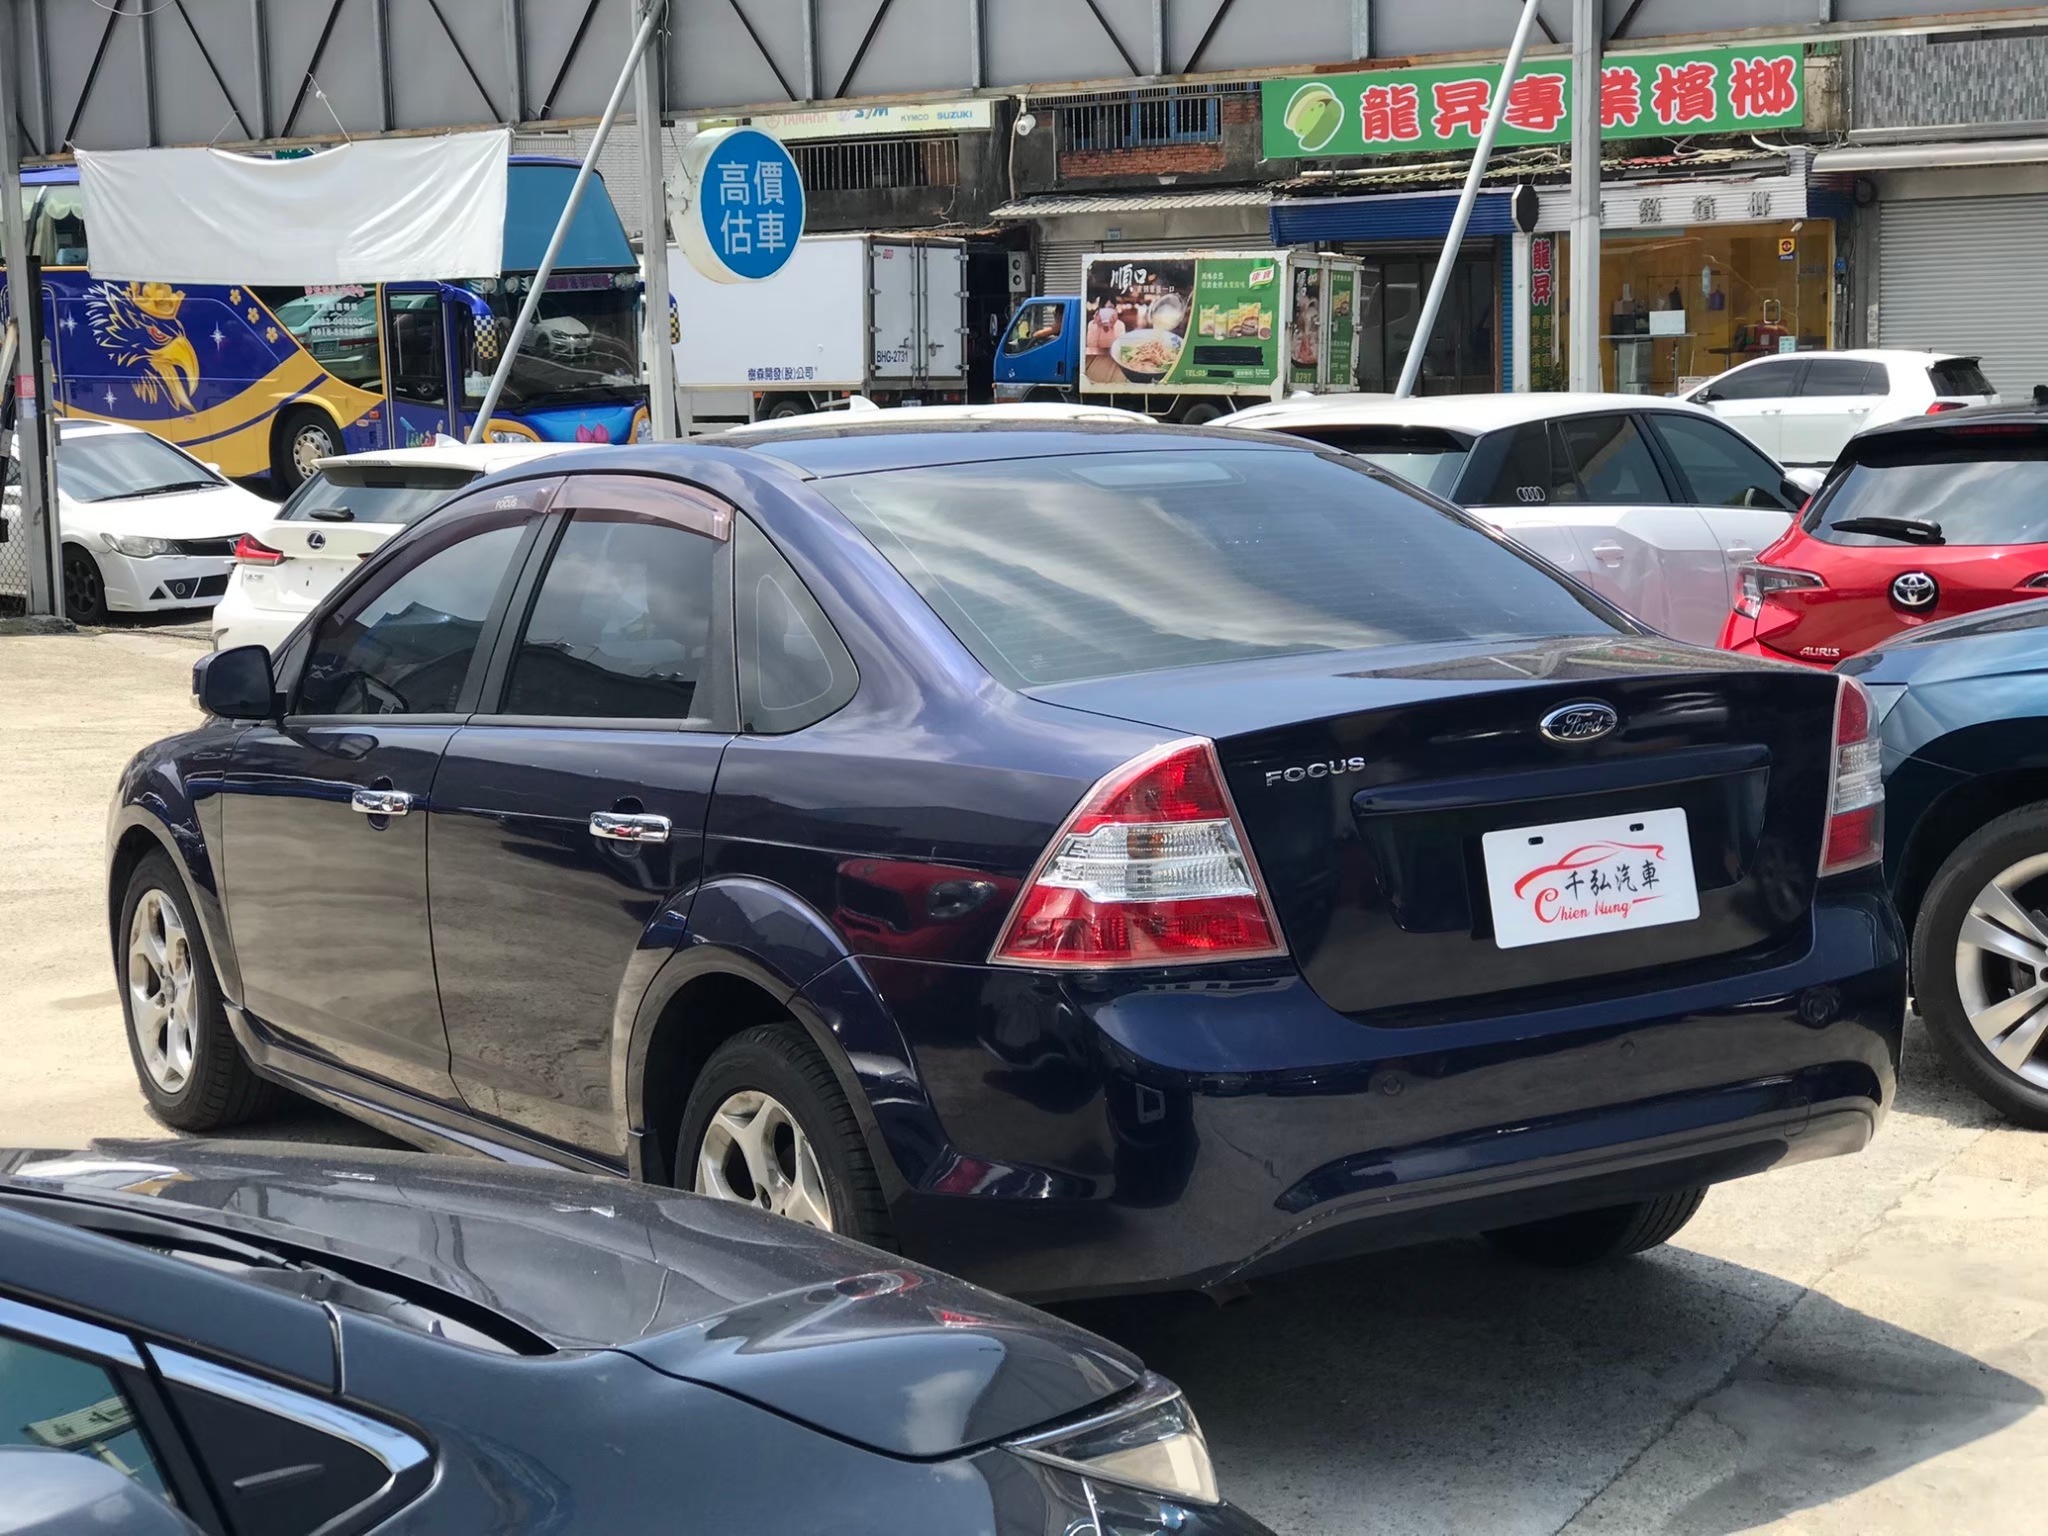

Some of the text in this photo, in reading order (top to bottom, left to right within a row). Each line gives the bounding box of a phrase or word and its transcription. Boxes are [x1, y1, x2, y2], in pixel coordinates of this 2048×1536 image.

[937, 110, 973, 121] SUZUKI
[1360, 56, 1798, 142] 龍昇專業檳榔
[901, 113, 929, 122] KYMCO
[717, 160, 785, 205] 高價
[720, 209, 786, 254] 估車
[1532, 238, 1551, 306] 龍昇
[876, 350, 909, 363] BHG-2731
[1800, 646, 1840, 657] AURIS
[1562, 711, 1604, 737] Ford
[1265, 756, 1366, 787] FOCUS
[1564, 859, 1661, 901] 千弘汽車
[1534, 887, 1590, 923] Chien
